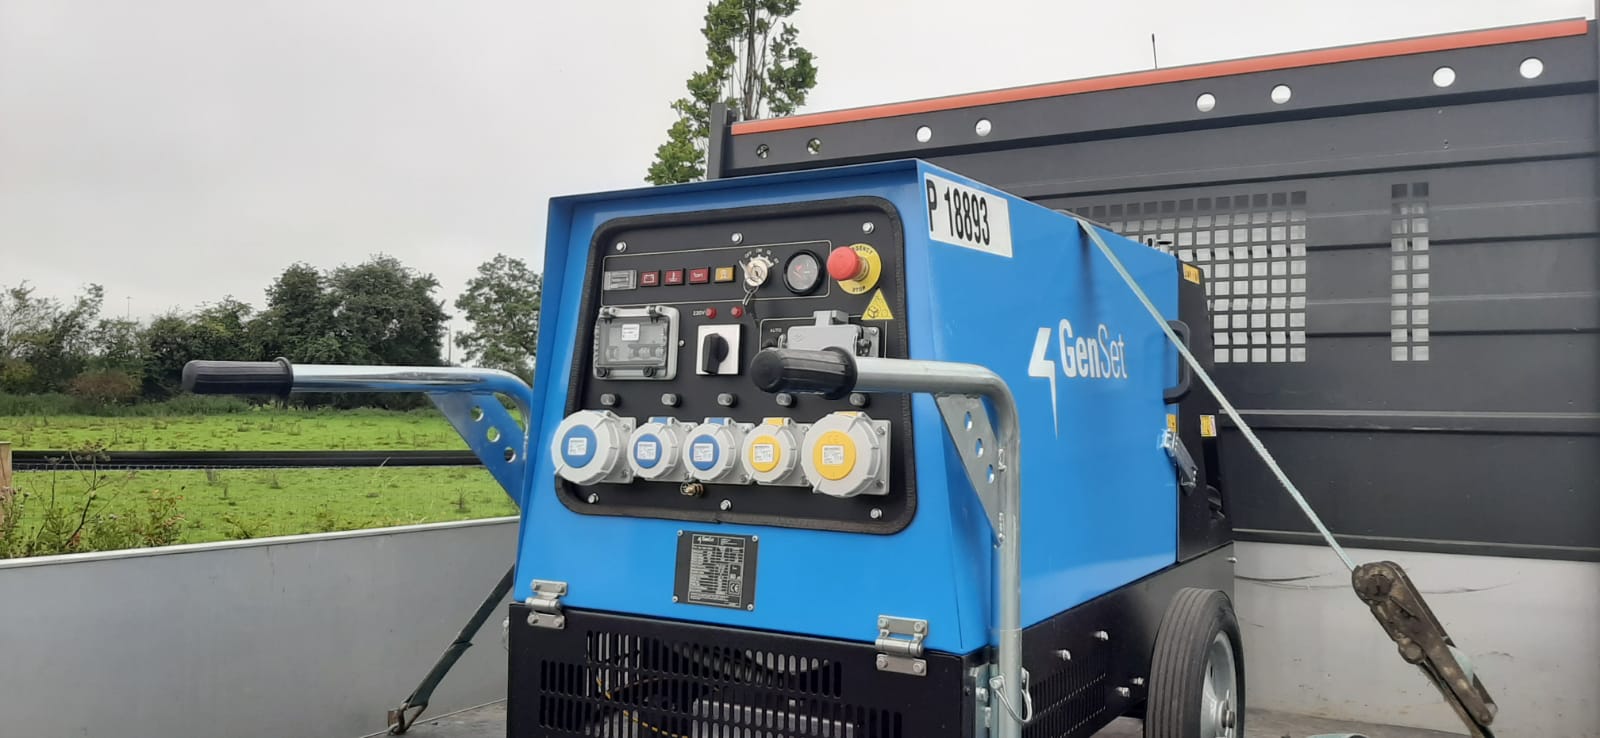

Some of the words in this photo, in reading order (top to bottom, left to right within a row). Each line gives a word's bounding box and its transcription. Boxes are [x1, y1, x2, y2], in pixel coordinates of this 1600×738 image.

[926, 179, 937, 232] P
[944, 186, 990, 246] 18893
[1058, 318, 1128, 379] GenSet
